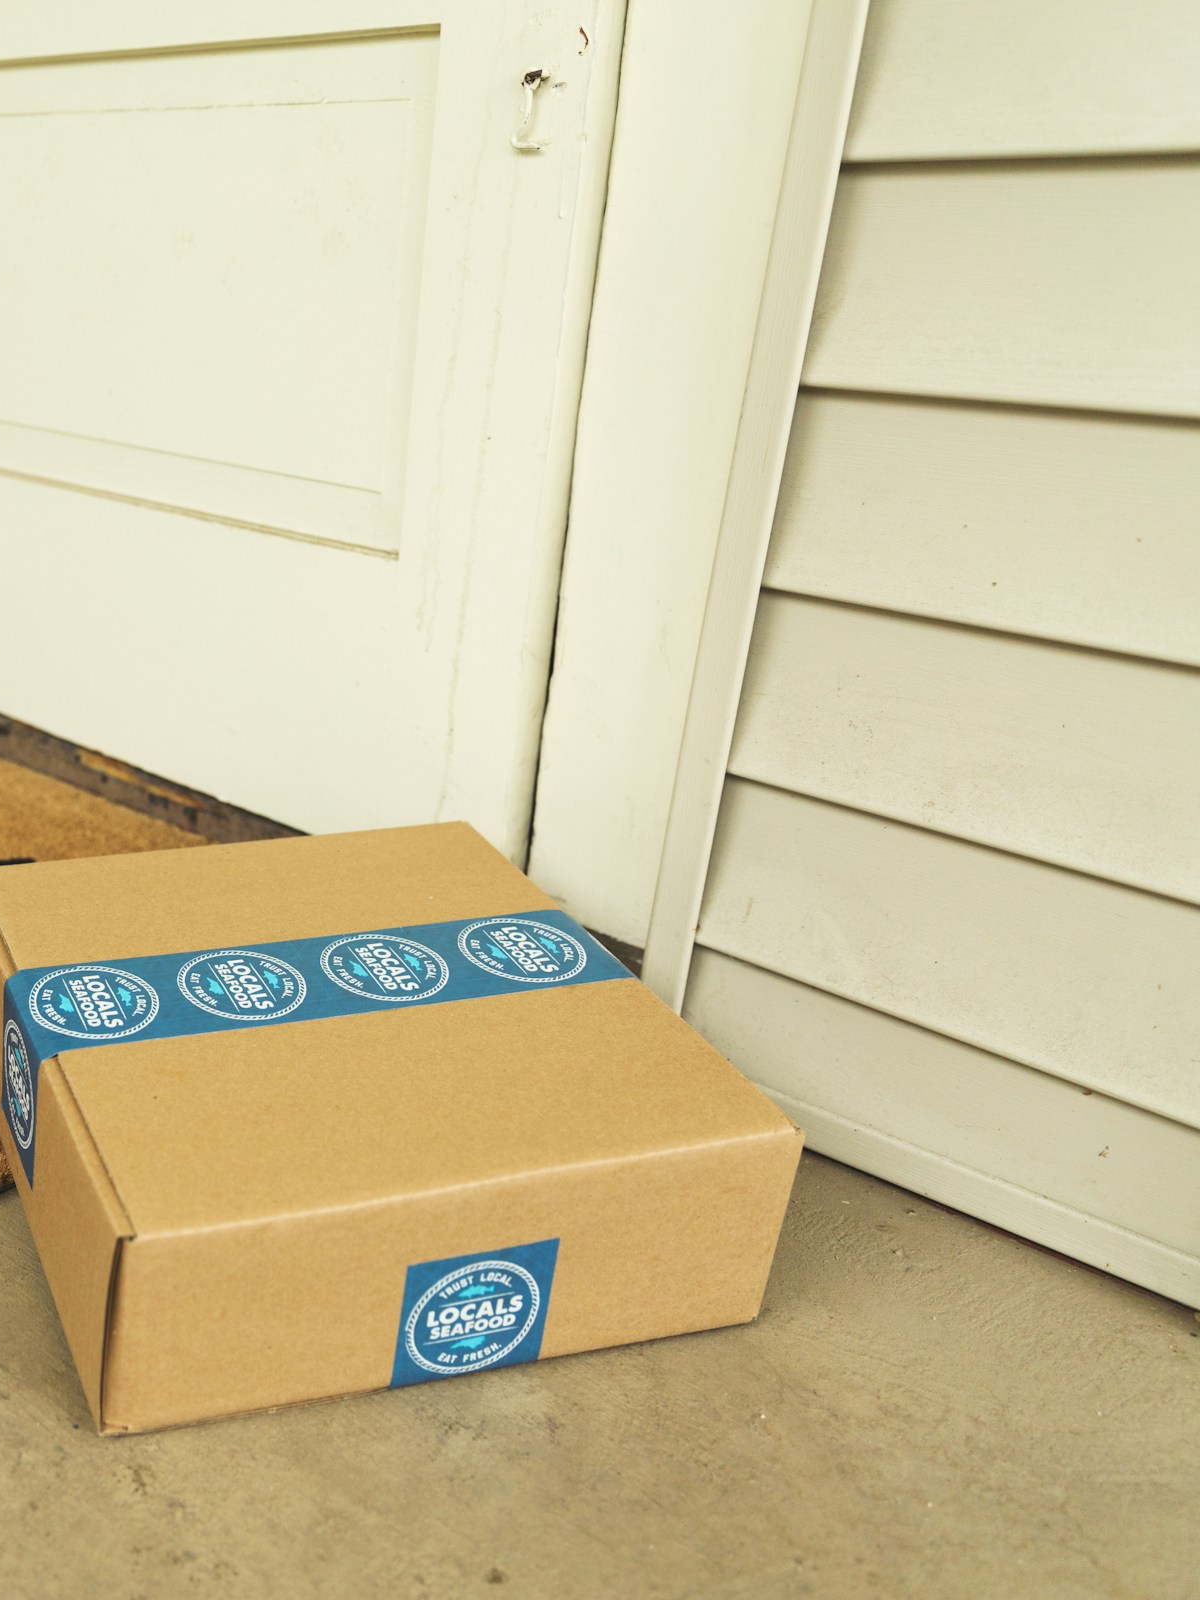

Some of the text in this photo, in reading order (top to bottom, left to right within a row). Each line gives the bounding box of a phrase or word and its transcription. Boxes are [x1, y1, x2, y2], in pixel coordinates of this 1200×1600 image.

[399, 944, 427, 959] TRUST
[470, 939, 480, 949] EAT
[490, 931, 538, 972] SEAFOOD
[501, 926, 559, 972] LOCALS
[533, 928, 562, 942] TRUST
[260, 961, 287, 976] TRUST
[333, 956, 342, 966] EAT
[355, 947, 398, 990] SEAFOOD
[367, 943, 419, 991] LOCALS
[115, 977, 141, 992] TRUST
[190, 972, 218, 1007] EAT FRESH.
[215, 964, 252, 1008] SEAFOOD
[227, 959, 274, 1009] LOCALS
[42, 989, 65, 1025] EAT FRESH.
[69, 980, 101, 1027] SEAFOOD
[82, 975, 123, 1028] LOCALS
[439, 1272, 512, 1299] TRUST LOCAL.
[427, 1295, 523, 1327] LOCALS
[430, 1314, 516, 1340] SEAFOOD
[437, 1342, 502, 1363] EAT FRESH.
